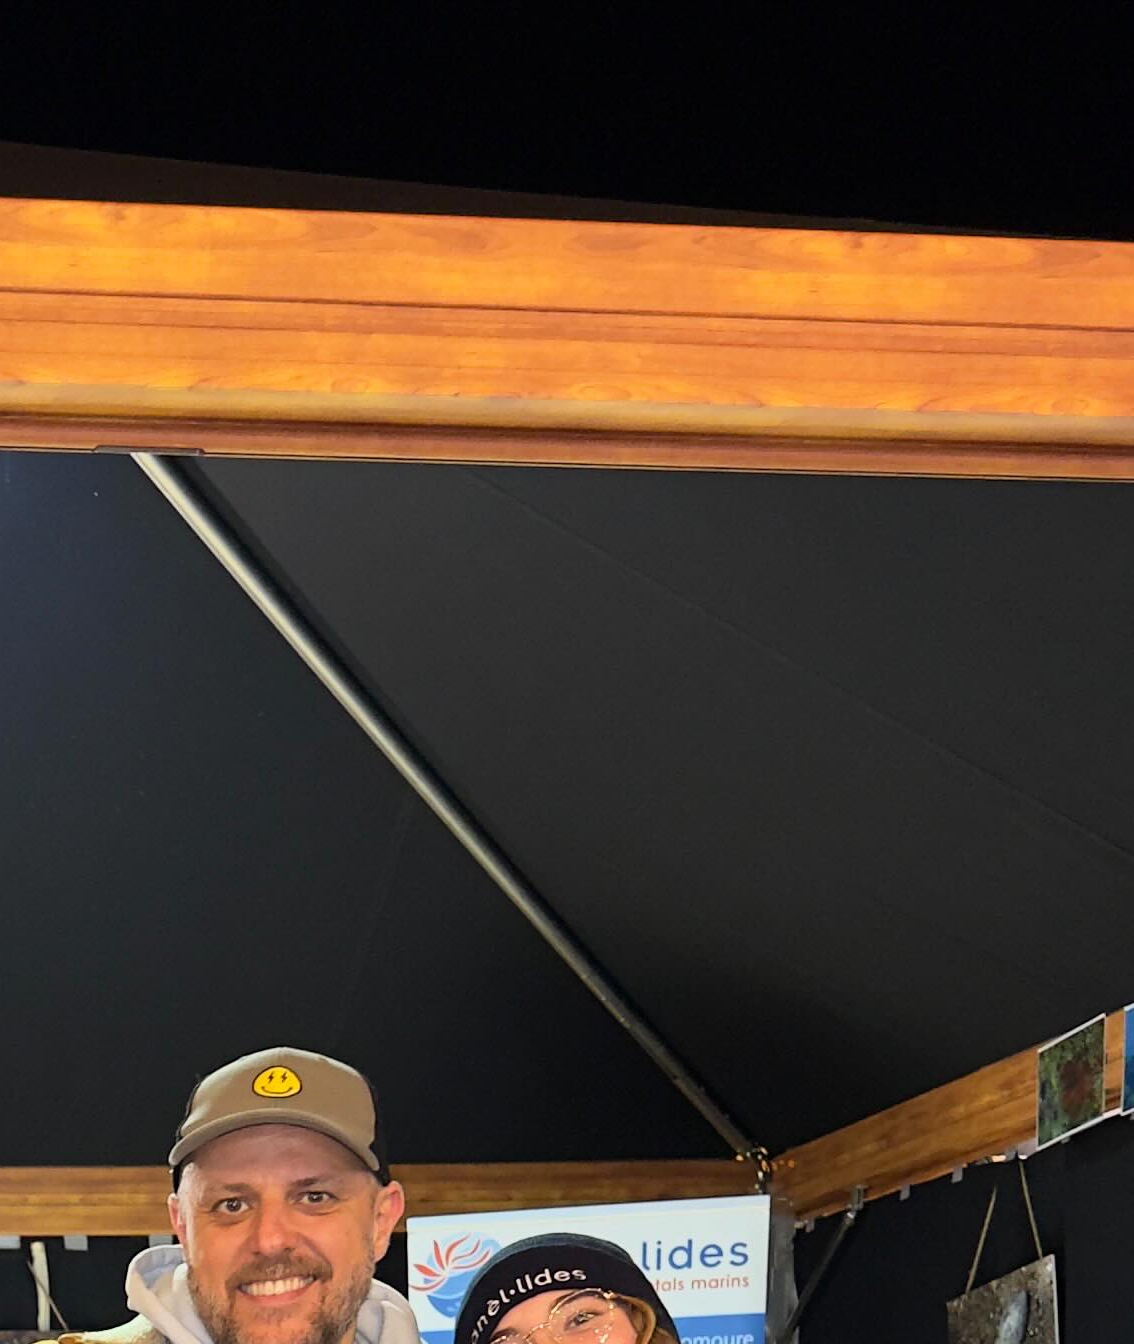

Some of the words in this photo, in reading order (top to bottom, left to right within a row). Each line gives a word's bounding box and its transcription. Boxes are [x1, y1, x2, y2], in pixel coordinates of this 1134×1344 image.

[641, 1238, 750, 1271] lides
[655, 1278, 685, 1292] tals
[691, 1274, 751, 1290] marins
